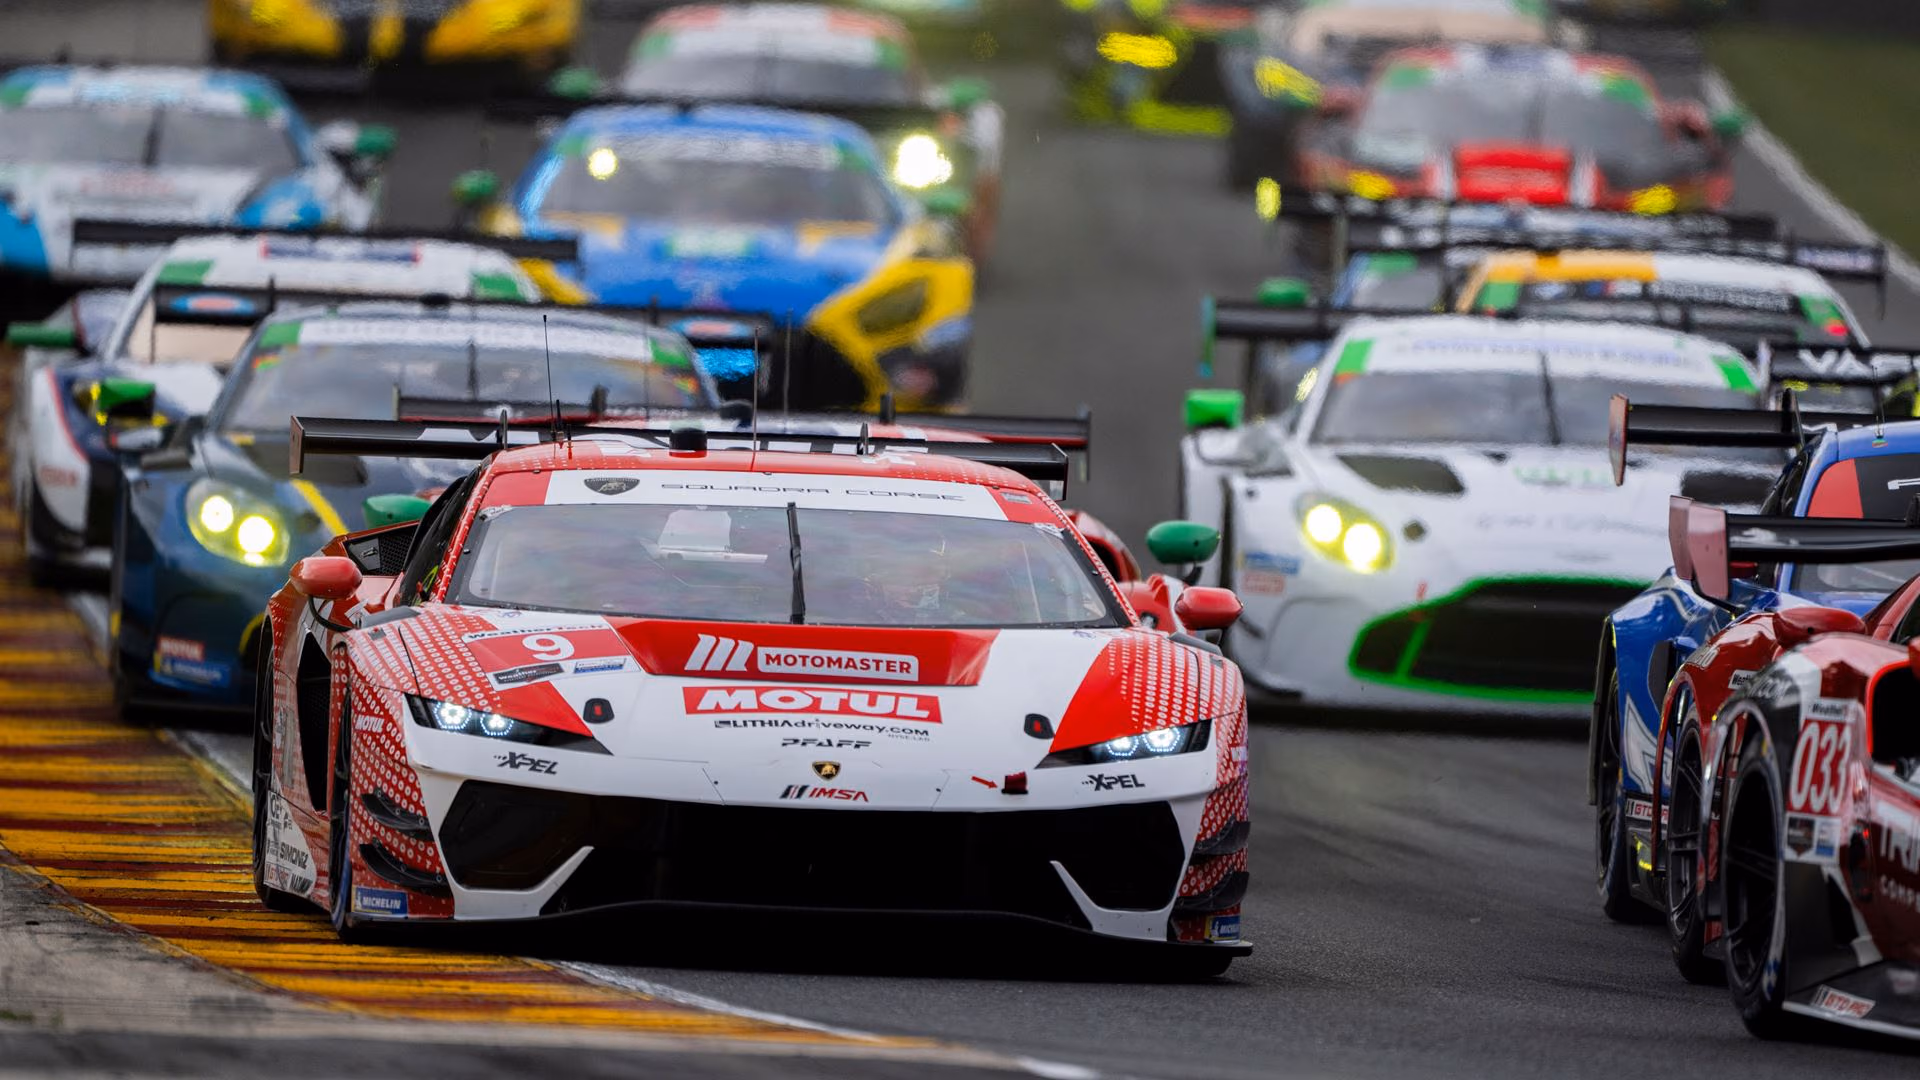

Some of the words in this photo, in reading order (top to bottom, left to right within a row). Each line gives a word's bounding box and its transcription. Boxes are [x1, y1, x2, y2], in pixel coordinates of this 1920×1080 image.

[661, 484, 829, 493] SQUADRA
[846, 489, 966, 501] CORSE
[522, 634, 574, 661] 9
[765, 653, 912, 674] MOTOMASTER
[697, 689, 930, 719] MOTUL
[355, 715, 384, 732] MOTUL
[781, 738, 872, 749] PFAFF
[497, 752, 558, 775] XPEL
[1790, 722, 1850, 814] 033
[1088, 773, 1145, 791] XPEL
[809, 787, 869, 802] IMSA
[362, 896, 401, 909] MICHELIN
